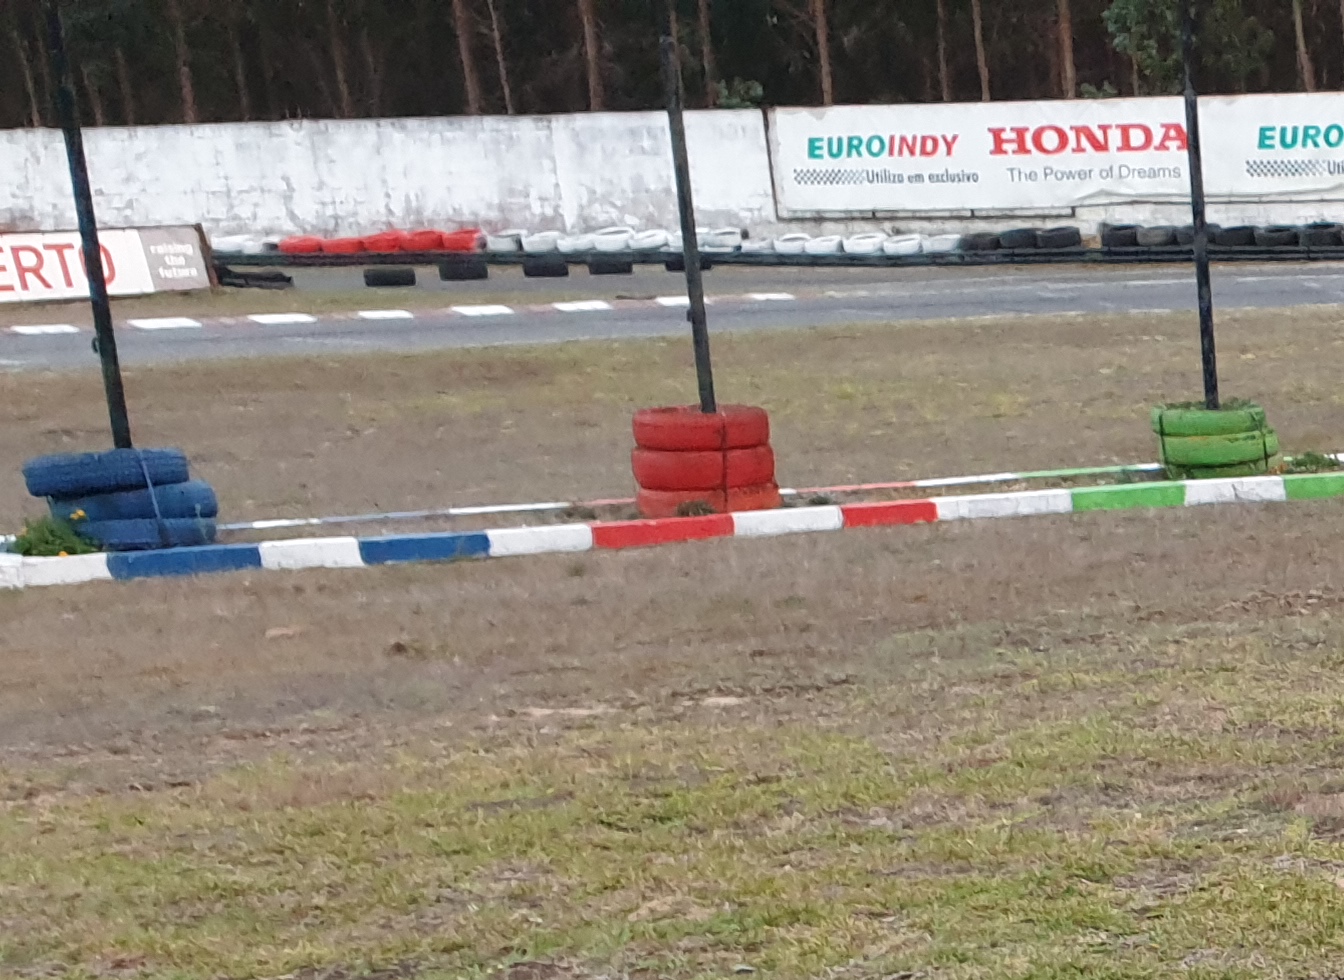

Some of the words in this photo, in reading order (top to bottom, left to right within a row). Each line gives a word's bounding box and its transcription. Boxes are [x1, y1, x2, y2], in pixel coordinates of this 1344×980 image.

[807, 134, 959, 160] EUROINDY
[987, 123, 1188, 155] HONDA
[866, 169, 905, 184] Utiliza
[907, 173, 925, 184] em
[927, 169, 979, 184] exclusivo
[1007, 166, 1038, 182] The
[1043, 166, 1093, 181] Power
[1099, 165, 1115, 179] of
[1119, 164, 1181, 179] Dreams
